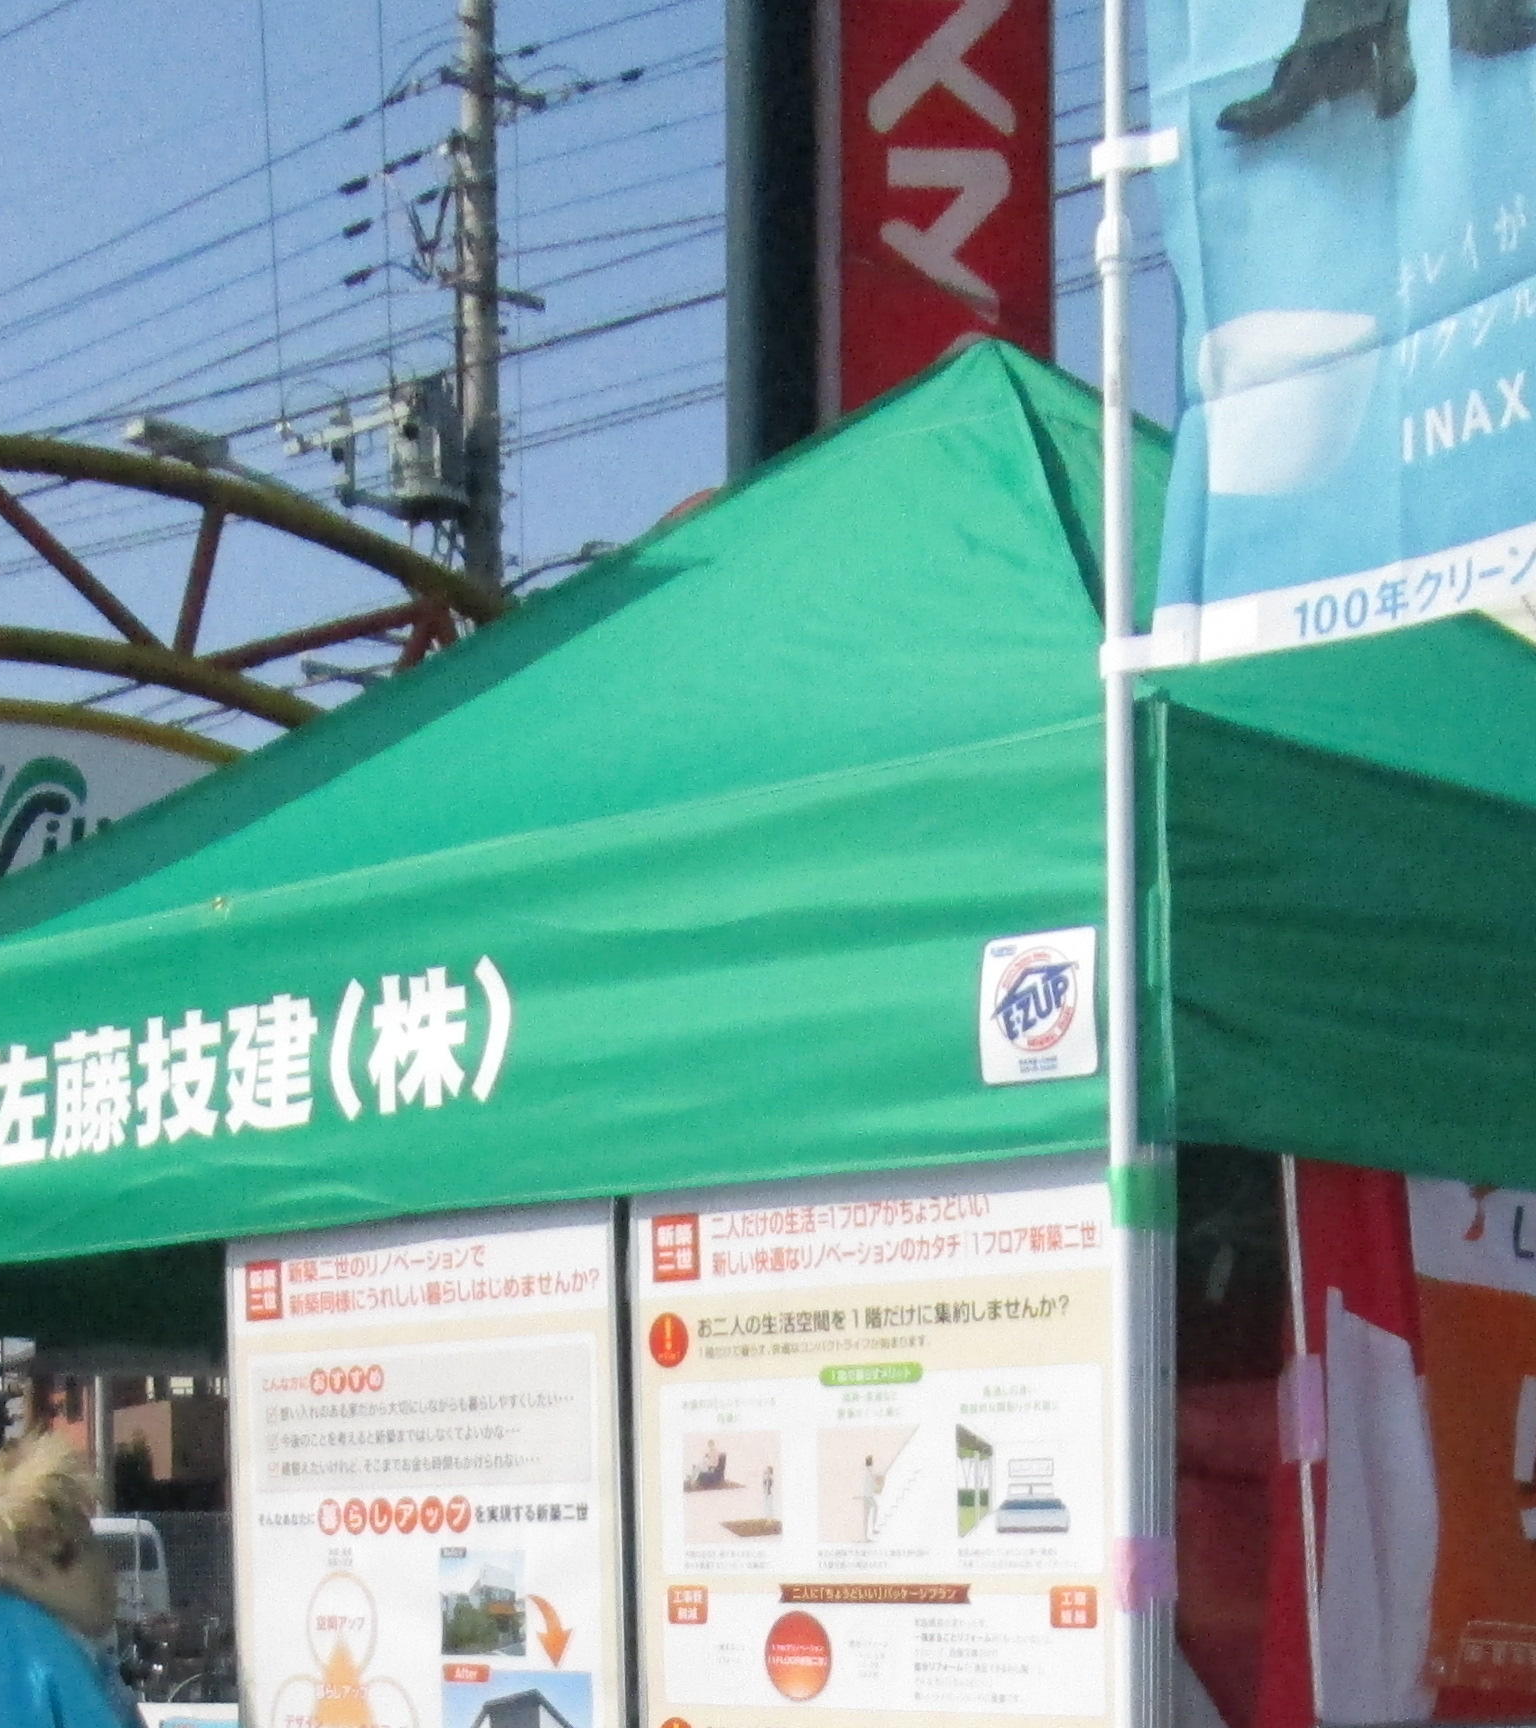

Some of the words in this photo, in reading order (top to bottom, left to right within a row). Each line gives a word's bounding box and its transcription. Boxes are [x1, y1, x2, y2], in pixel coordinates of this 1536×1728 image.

[1403, 370, 1531, 464] INAX
[288, 1245, 486, 1282] 新築二世のリノベーションで
